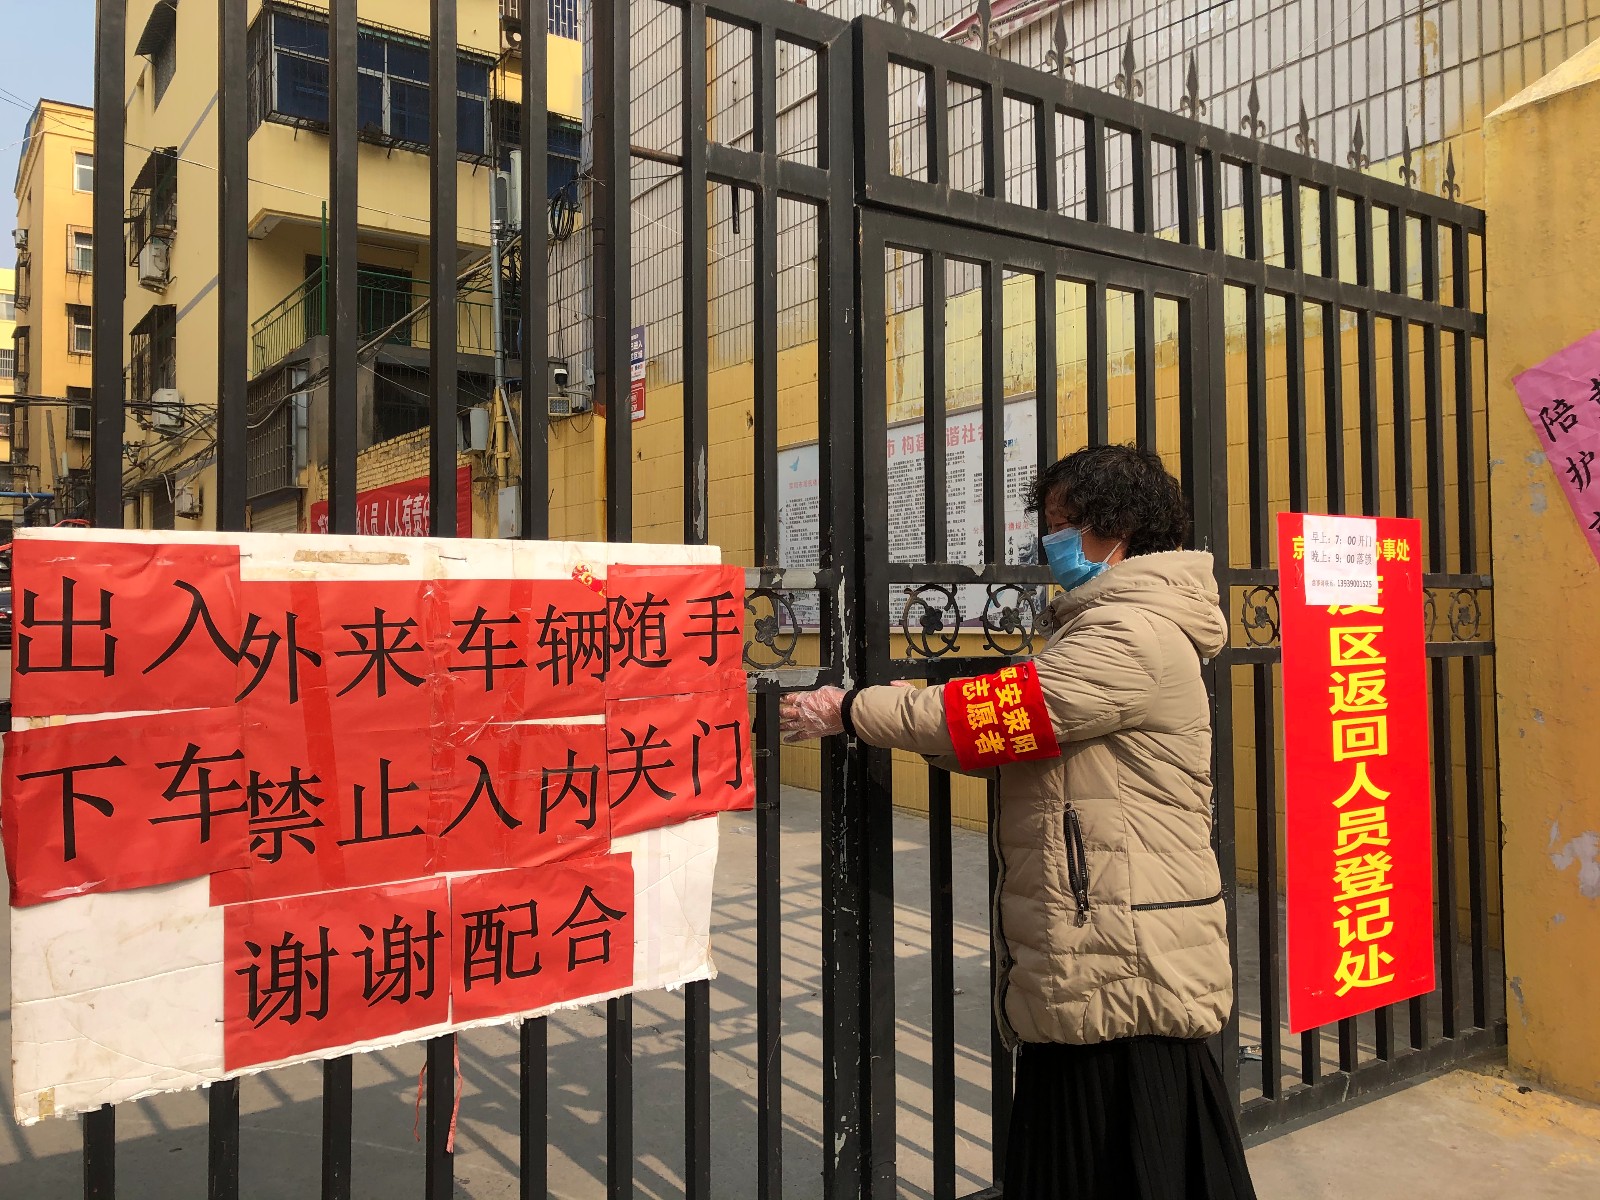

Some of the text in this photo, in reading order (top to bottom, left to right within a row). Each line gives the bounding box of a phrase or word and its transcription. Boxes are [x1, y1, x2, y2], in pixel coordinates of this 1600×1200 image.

[962, 678, 1006, 754] 志愿者
[235, 885, 628, 1030] 谢谢配合
